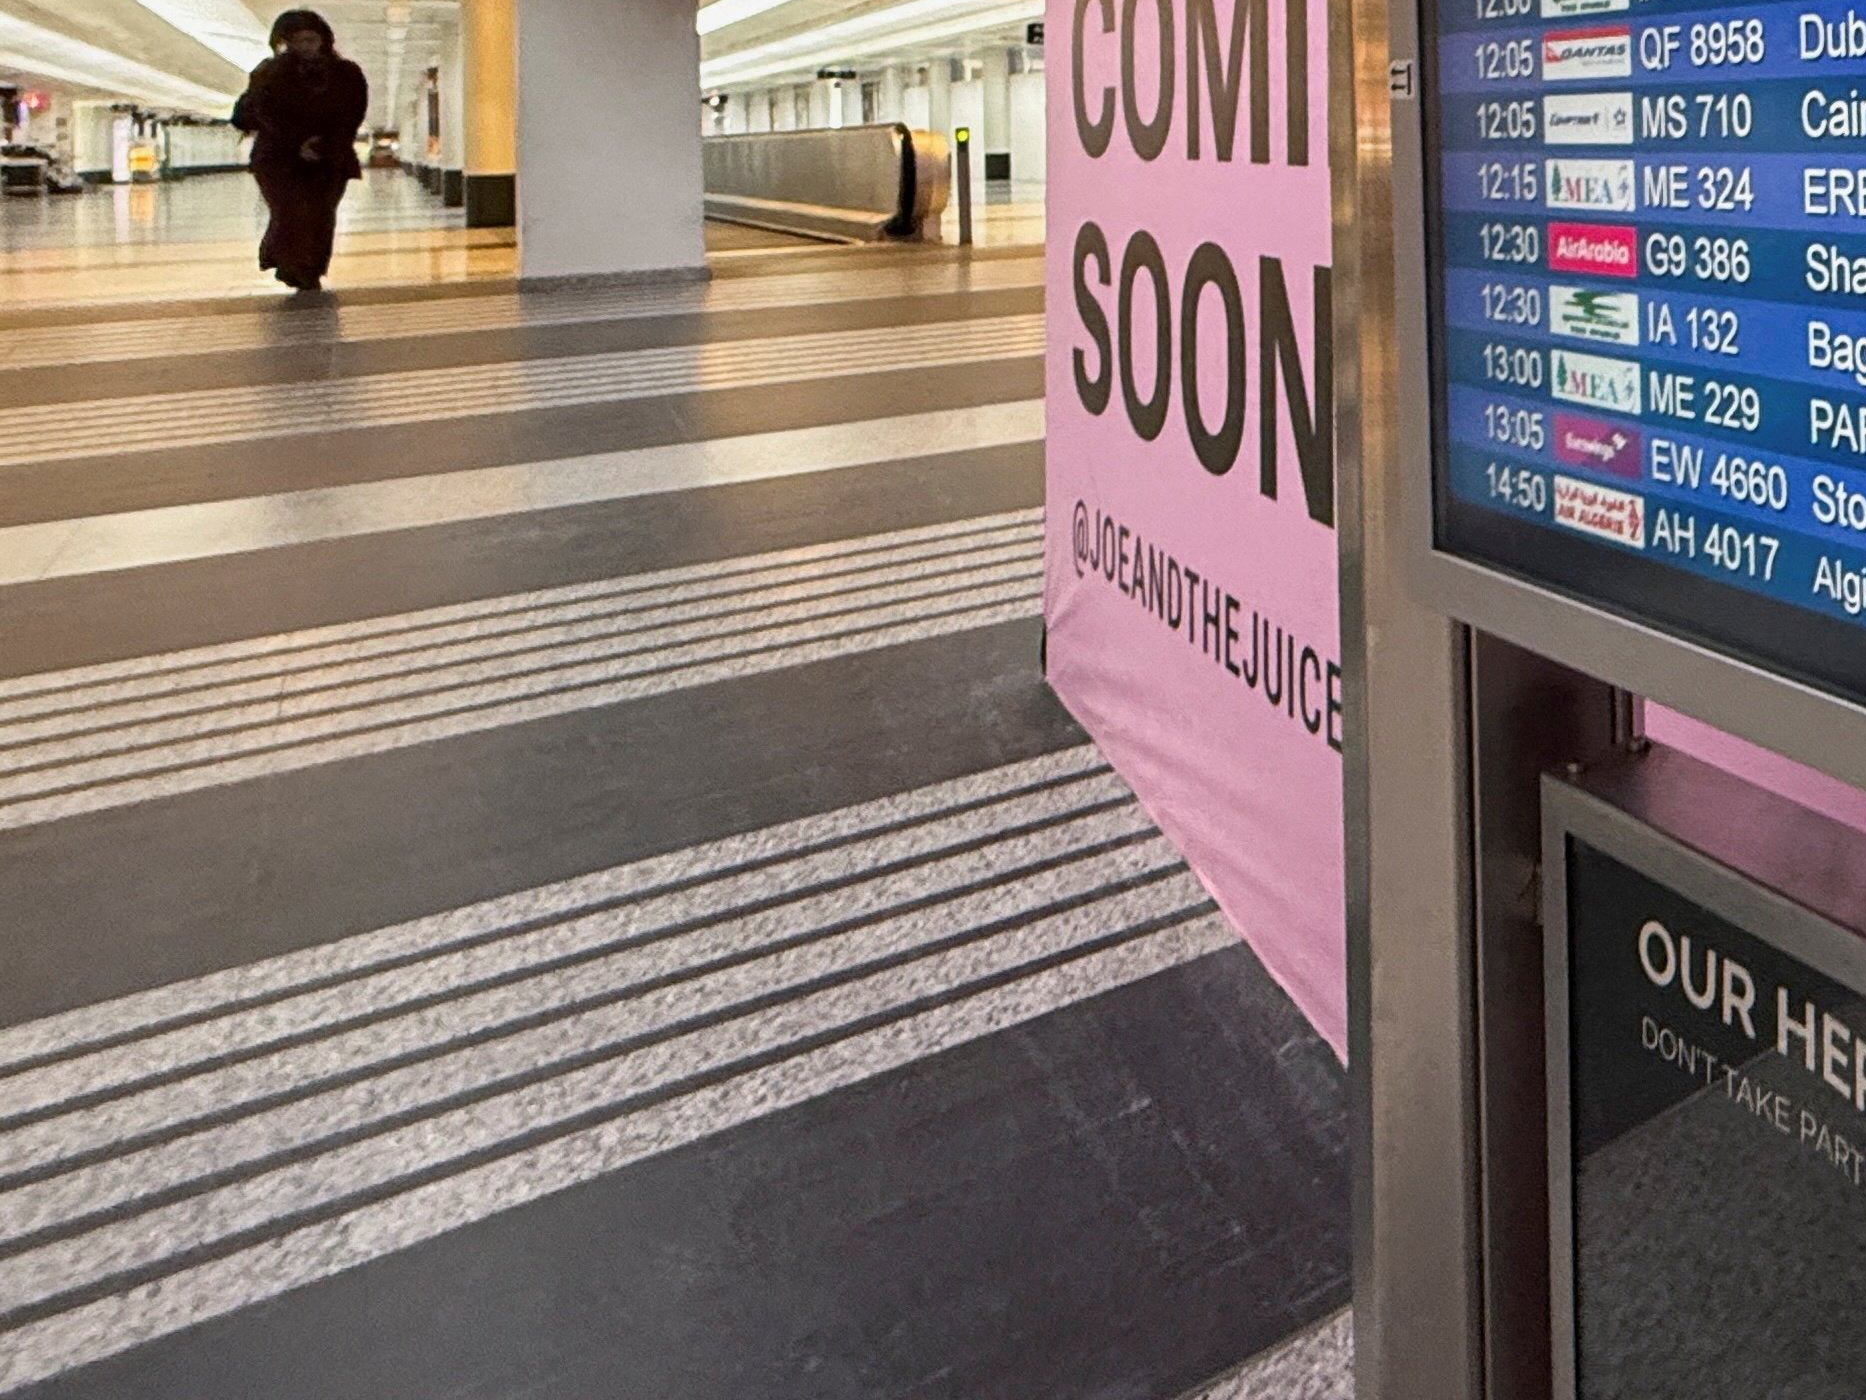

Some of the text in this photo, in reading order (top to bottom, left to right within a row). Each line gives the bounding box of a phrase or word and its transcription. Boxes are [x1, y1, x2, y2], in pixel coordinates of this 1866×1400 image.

[1475, 40, 1533, 78] 12:05
[1561, 44, 1626, 60] QANTAS
[1640, 19, 1764, 69] QF 8958
[1477, 101, 1535, 138] 12:05
[1642, 94, 1751, 138] MS 710
[1478, 163, 1536, 200] 12:15
[1644, 166, 1753, 210] ME 324
[1480, 224, 1538, 263] 12:30
[1646, 233, 1749, 282] G9 386
[1482, 284, 1540, 325] 12:30
[1648, 302, 1738, 354] IA 132
[1073, 221, 1334, 529] SOON
[1484, 344, 1542, 387] 13:00
[1650, 371, 1759, 430] ME 229
[1485, 405, 1544, 449] 13:05
[1487, 463, 1545, 511] 14:50
[1652, 439, 1703, 488] EW
[1711, 455, 1787, 509] 4660
[1653, 509, 1779, 580] AH 4017
[1073, 499, 1343, 755] @JOEANDTHEJUICE
[1638, 920, 1756, 1040] OUR
[1641, 1015, 1718, 1083] DON'T
[1722, 1063, 1792, 1135] TAKE
[1799, 1108, 1866, 1186] PART
